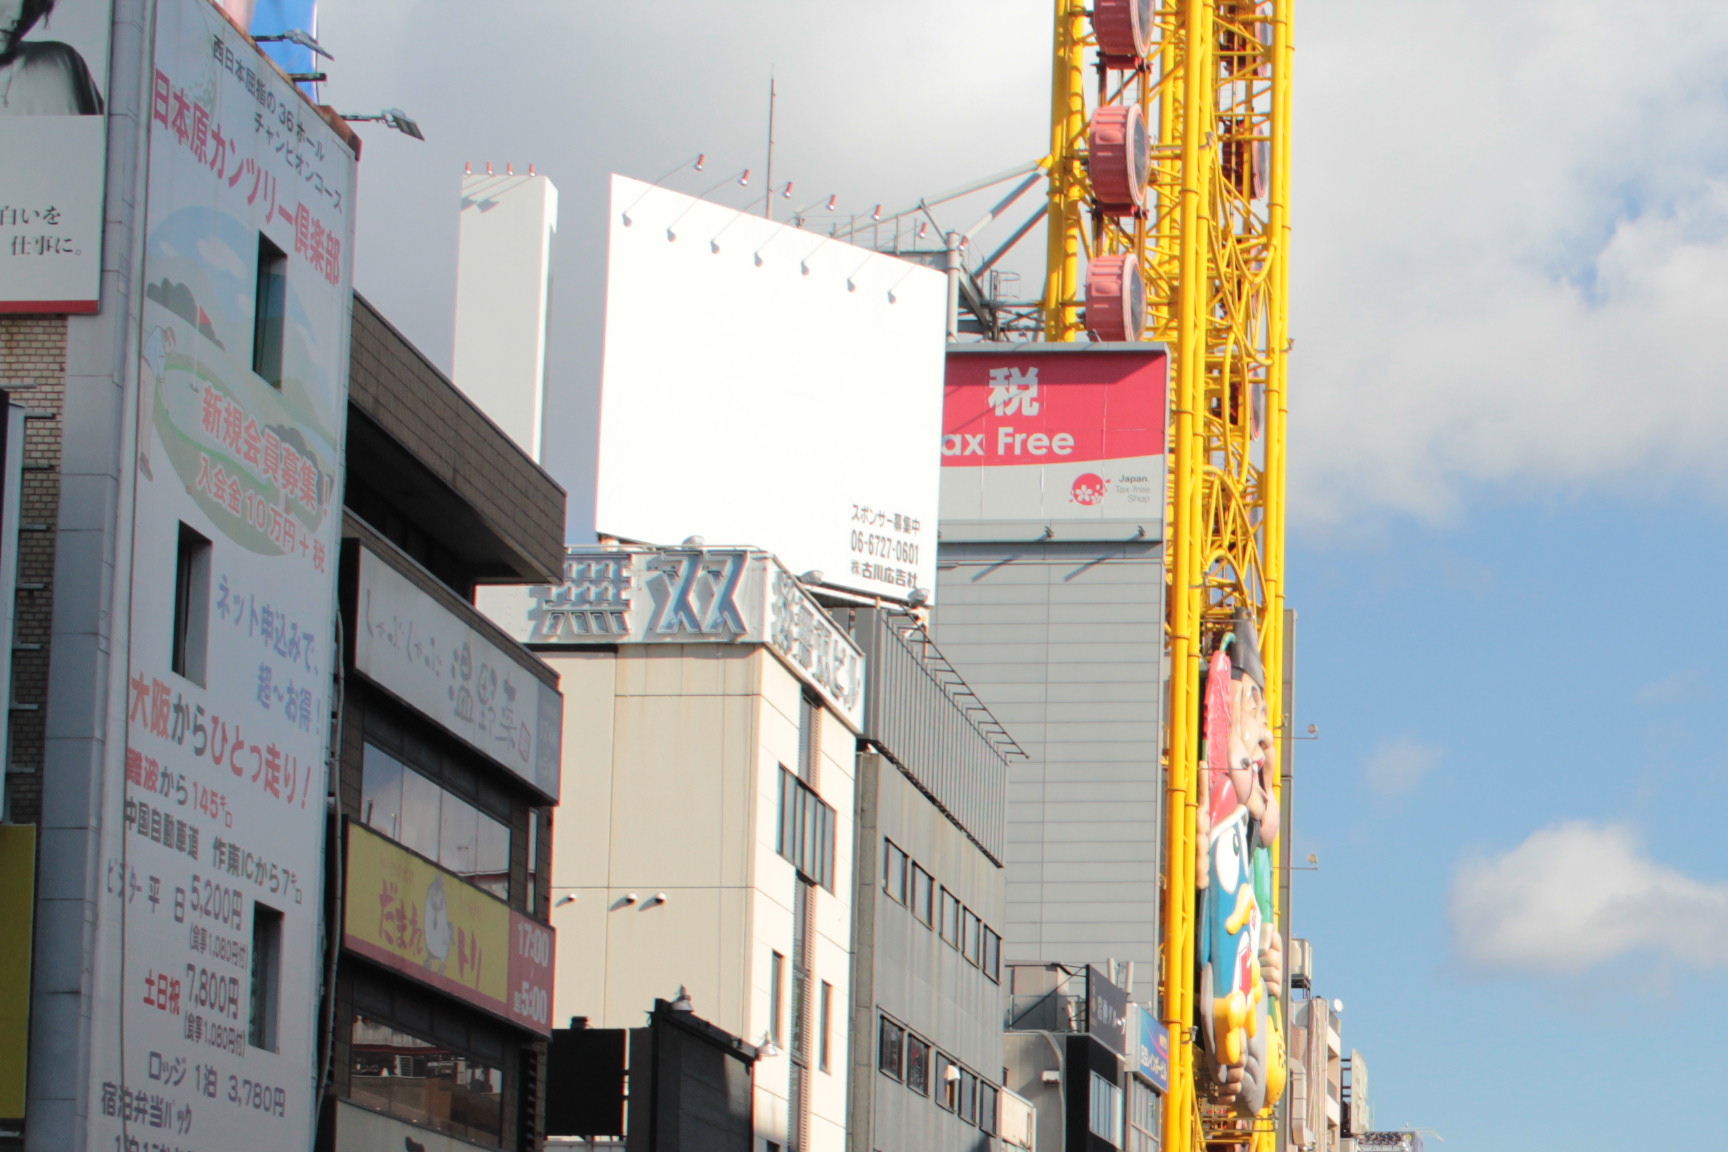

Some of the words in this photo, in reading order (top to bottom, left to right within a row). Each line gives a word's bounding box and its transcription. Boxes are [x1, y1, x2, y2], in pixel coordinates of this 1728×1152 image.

[213, 34, 325, 161] 西日本屈指の36ホール
[153, 68, 341, 287] 日本原カンツリー倶楽部
[253, 112, 342, 214] チャンピオンコース
[11, 236, 82, 256] 仕事に。
[987, 366, 1040, 417] 税
[997, 427, 1075, 456] Free
[850, 529, 920, 566] 06-6727-0601
[851, 503, 921, 537] スポンサー募集中
[124, 797, 200, 861] 中国自動車道
[191, 874, 244, 931] 5,200円
[517, 921, 549, 968] 17:00
[143, 967, 181, 1016] 土日祝
[186, 962, 240, 1020] 7,800円
[149, 1050, 187, 1087] ロッジ
[194, 1063, 218, 1099] 1泊
[227, 1075, 287, 1119] 3,780円
